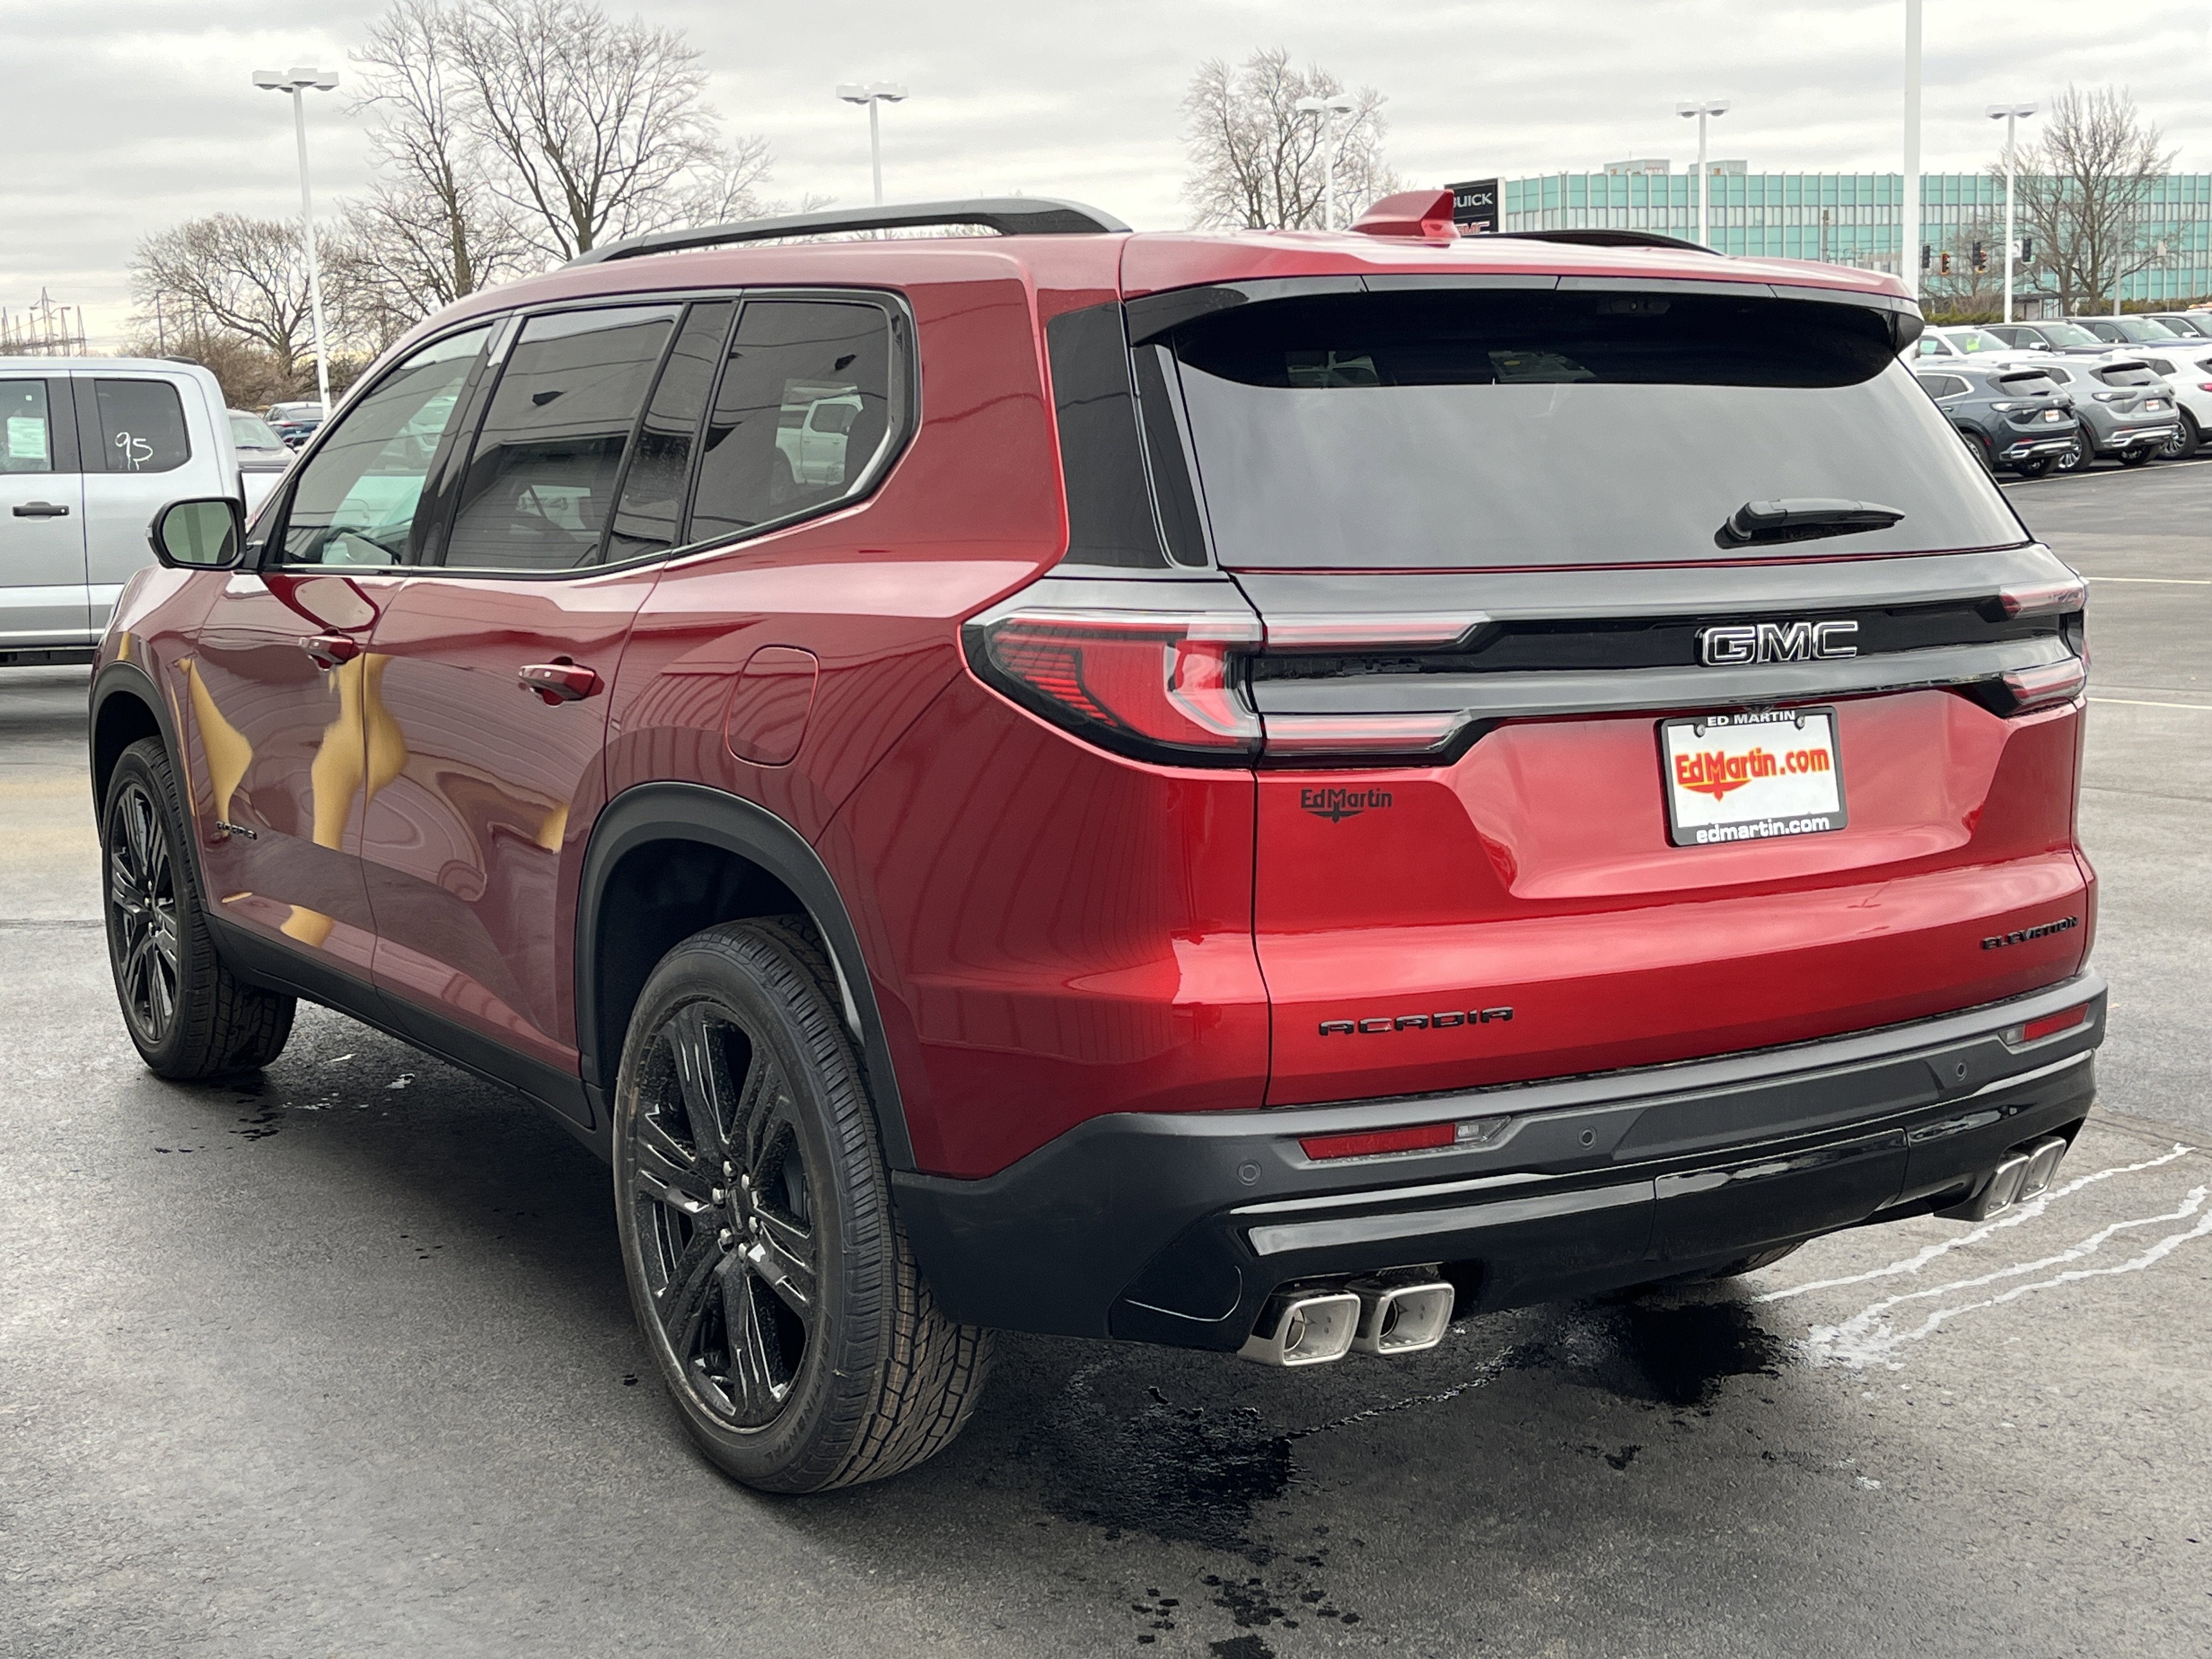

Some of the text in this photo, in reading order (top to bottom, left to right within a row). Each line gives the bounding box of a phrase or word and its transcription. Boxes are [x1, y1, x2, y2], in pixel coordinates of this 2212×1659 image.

[115, 432, 153, 466] 95
[1700, 620, 1859, 667] GMC
[1707, 709, 1796, 726] ED MARTIN
[1674, 746, 1830, 786] EdMartin.com
[1300, 787, 1393, 810] EdMartin
[1696, 815, 1830, 844] edmartin.com
[1980, 915, 2079, 950] ELEVATION
[1319, 1006, 1514, 1036] ACADIA
